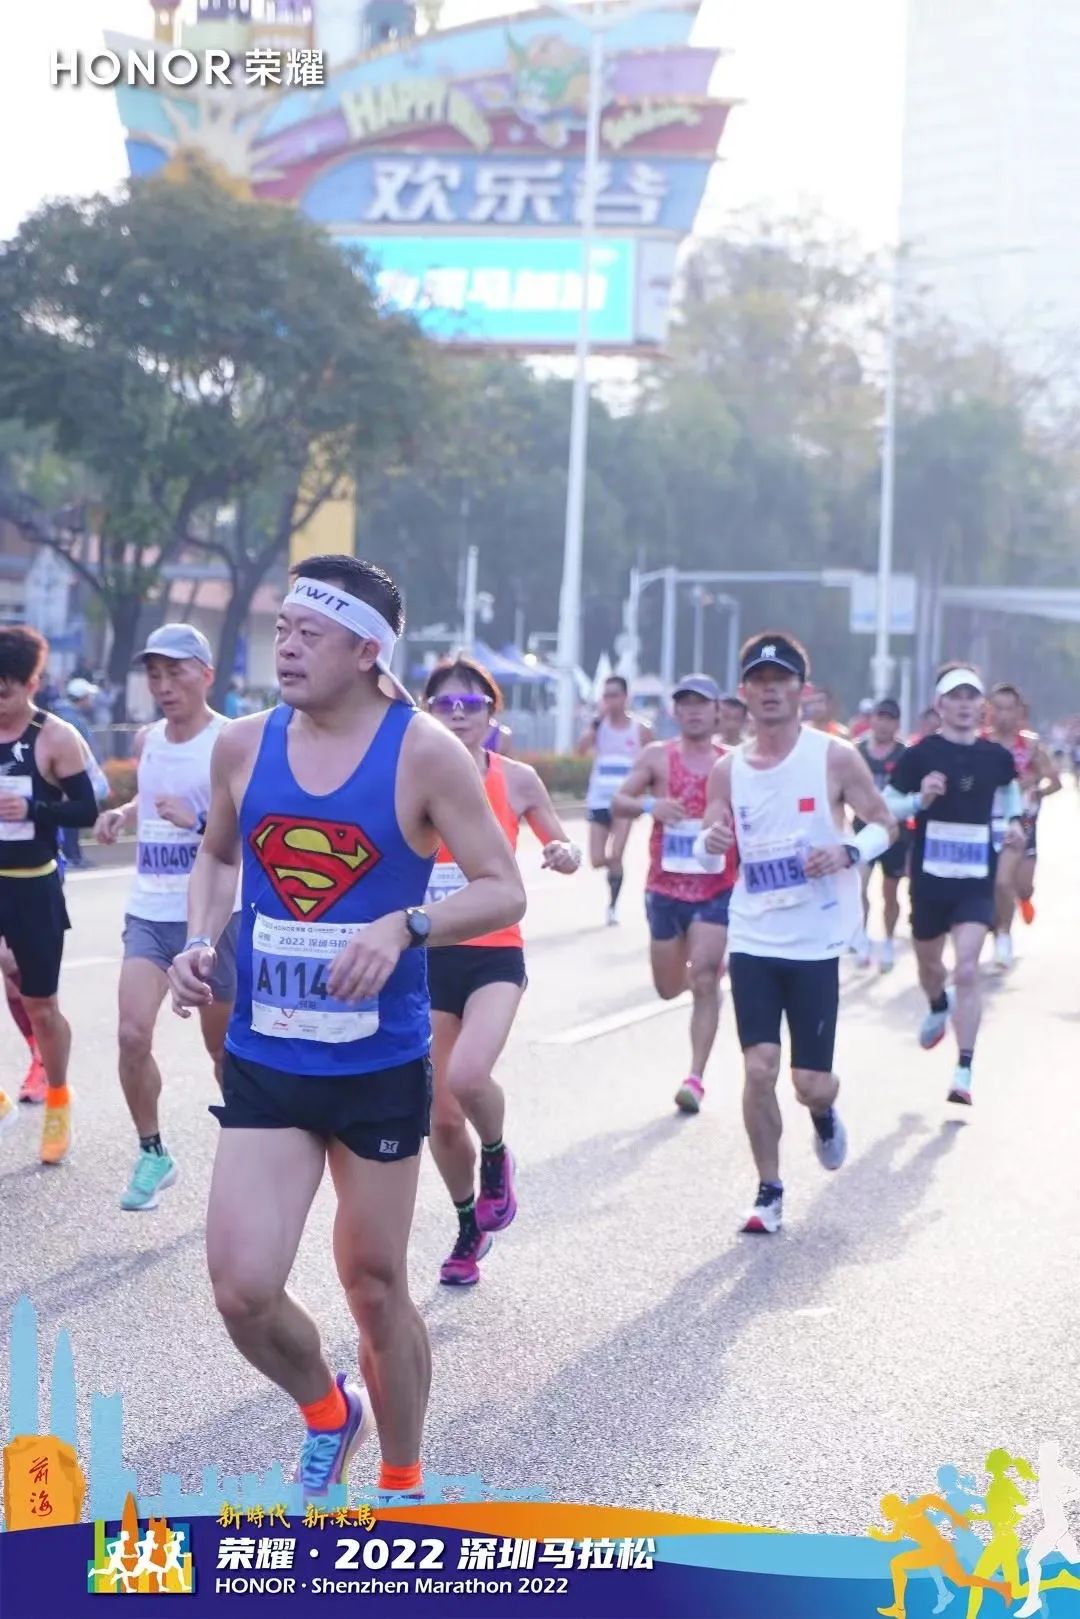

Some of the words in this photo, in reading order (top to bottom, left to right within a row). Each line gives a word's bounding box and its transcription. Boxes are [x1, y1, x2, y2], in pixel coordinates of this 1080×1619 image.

[364, 158, 667, 223] 欢乐谷
[750, 856, 805, 888] A1115
